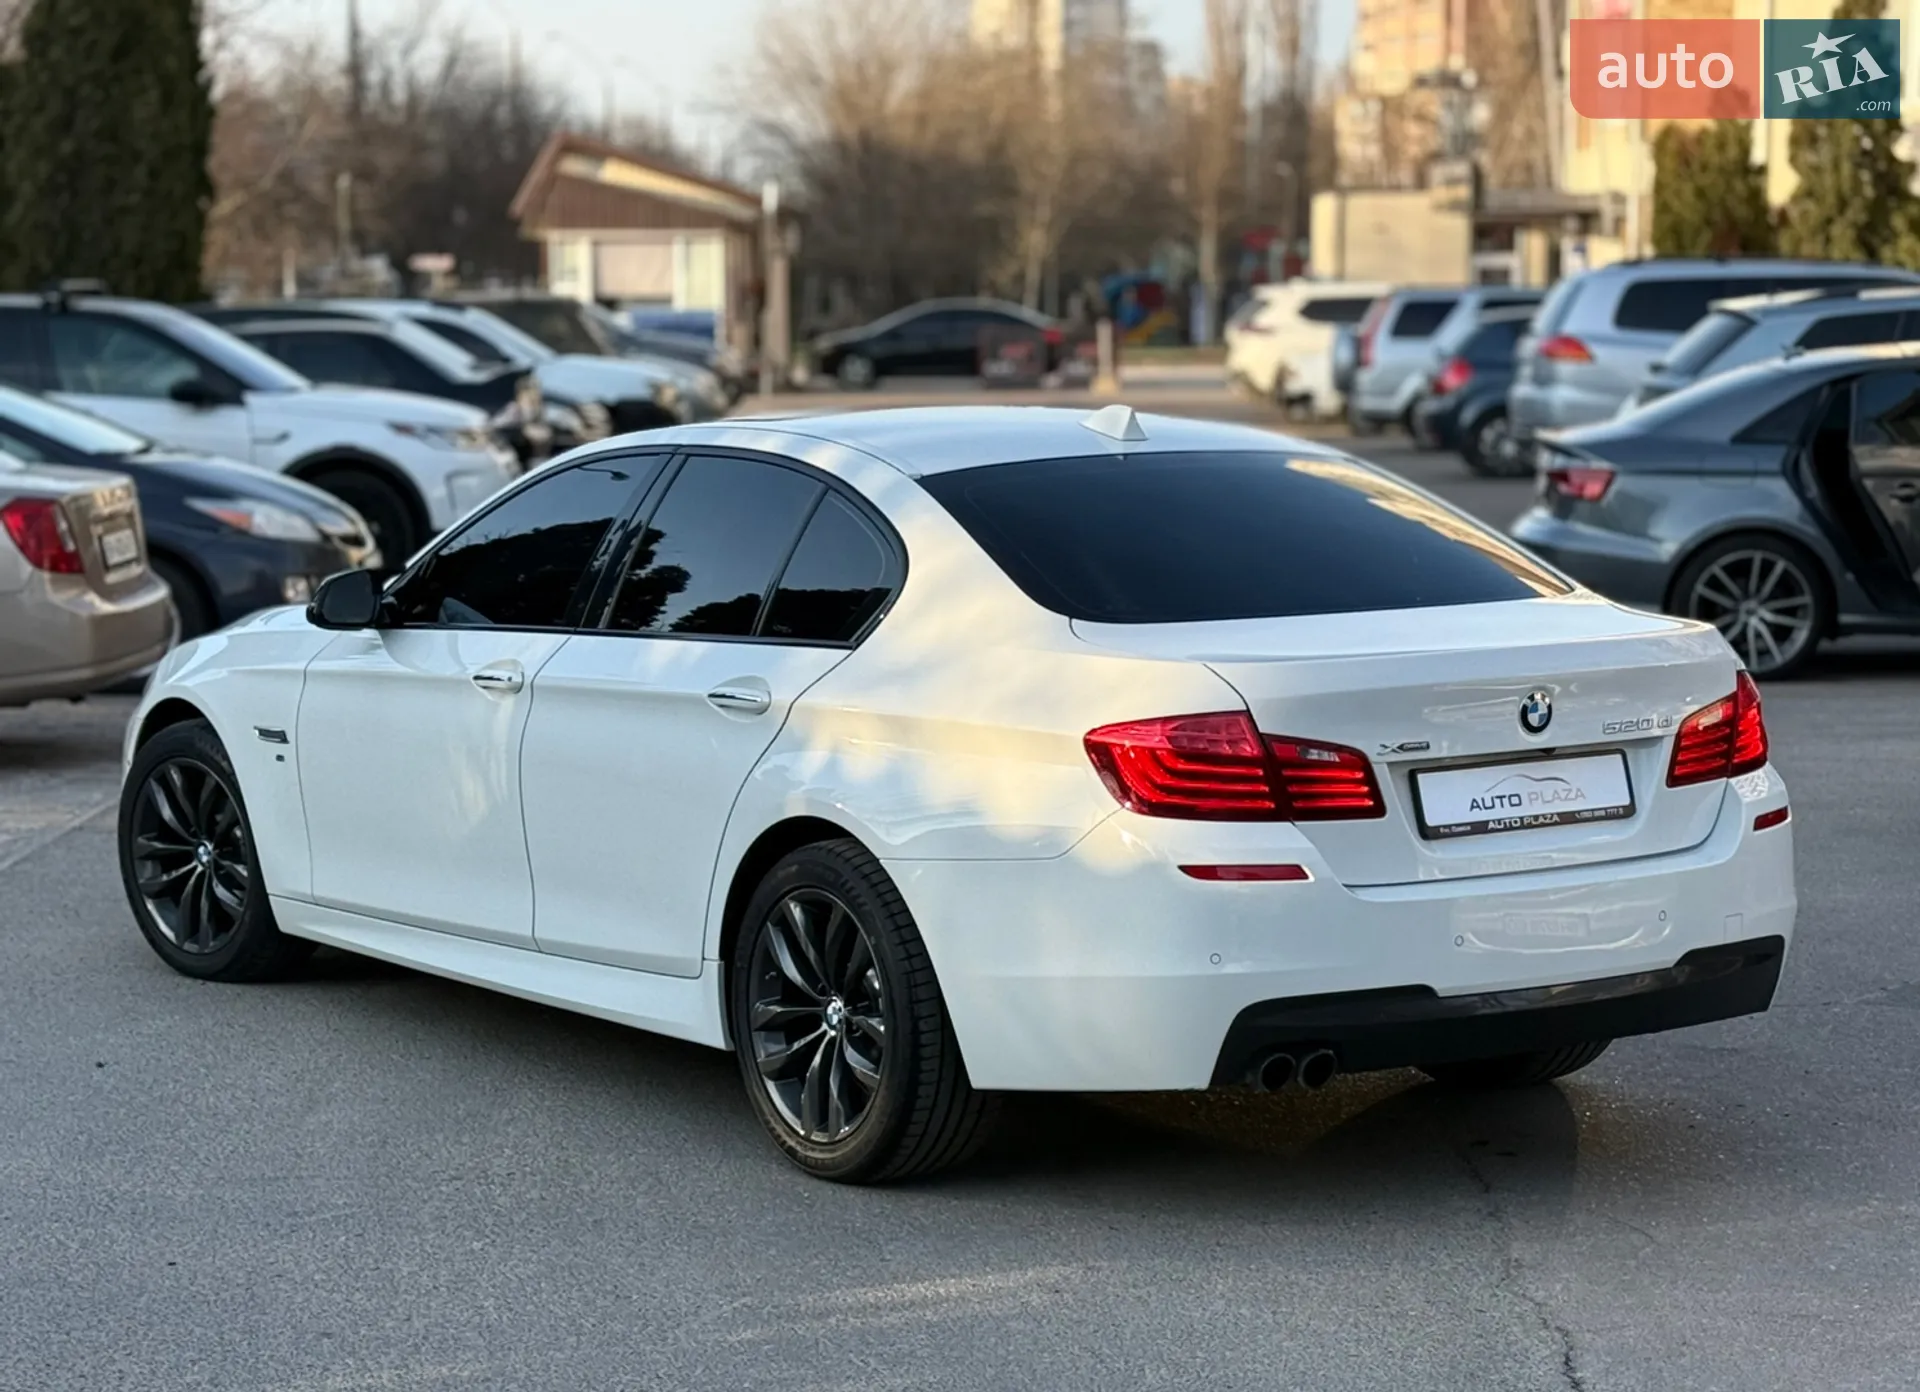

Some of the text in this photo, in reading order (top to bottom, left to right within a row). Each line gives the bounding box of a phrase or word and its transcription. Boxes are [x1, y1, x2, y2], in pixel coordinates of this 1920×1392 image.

[1602, 718, 1654, 736] 520
[1469, 787, 1586, 812] AUTO PLAZA
[1487, 814, 1560, 830] AUTO PLAZA
